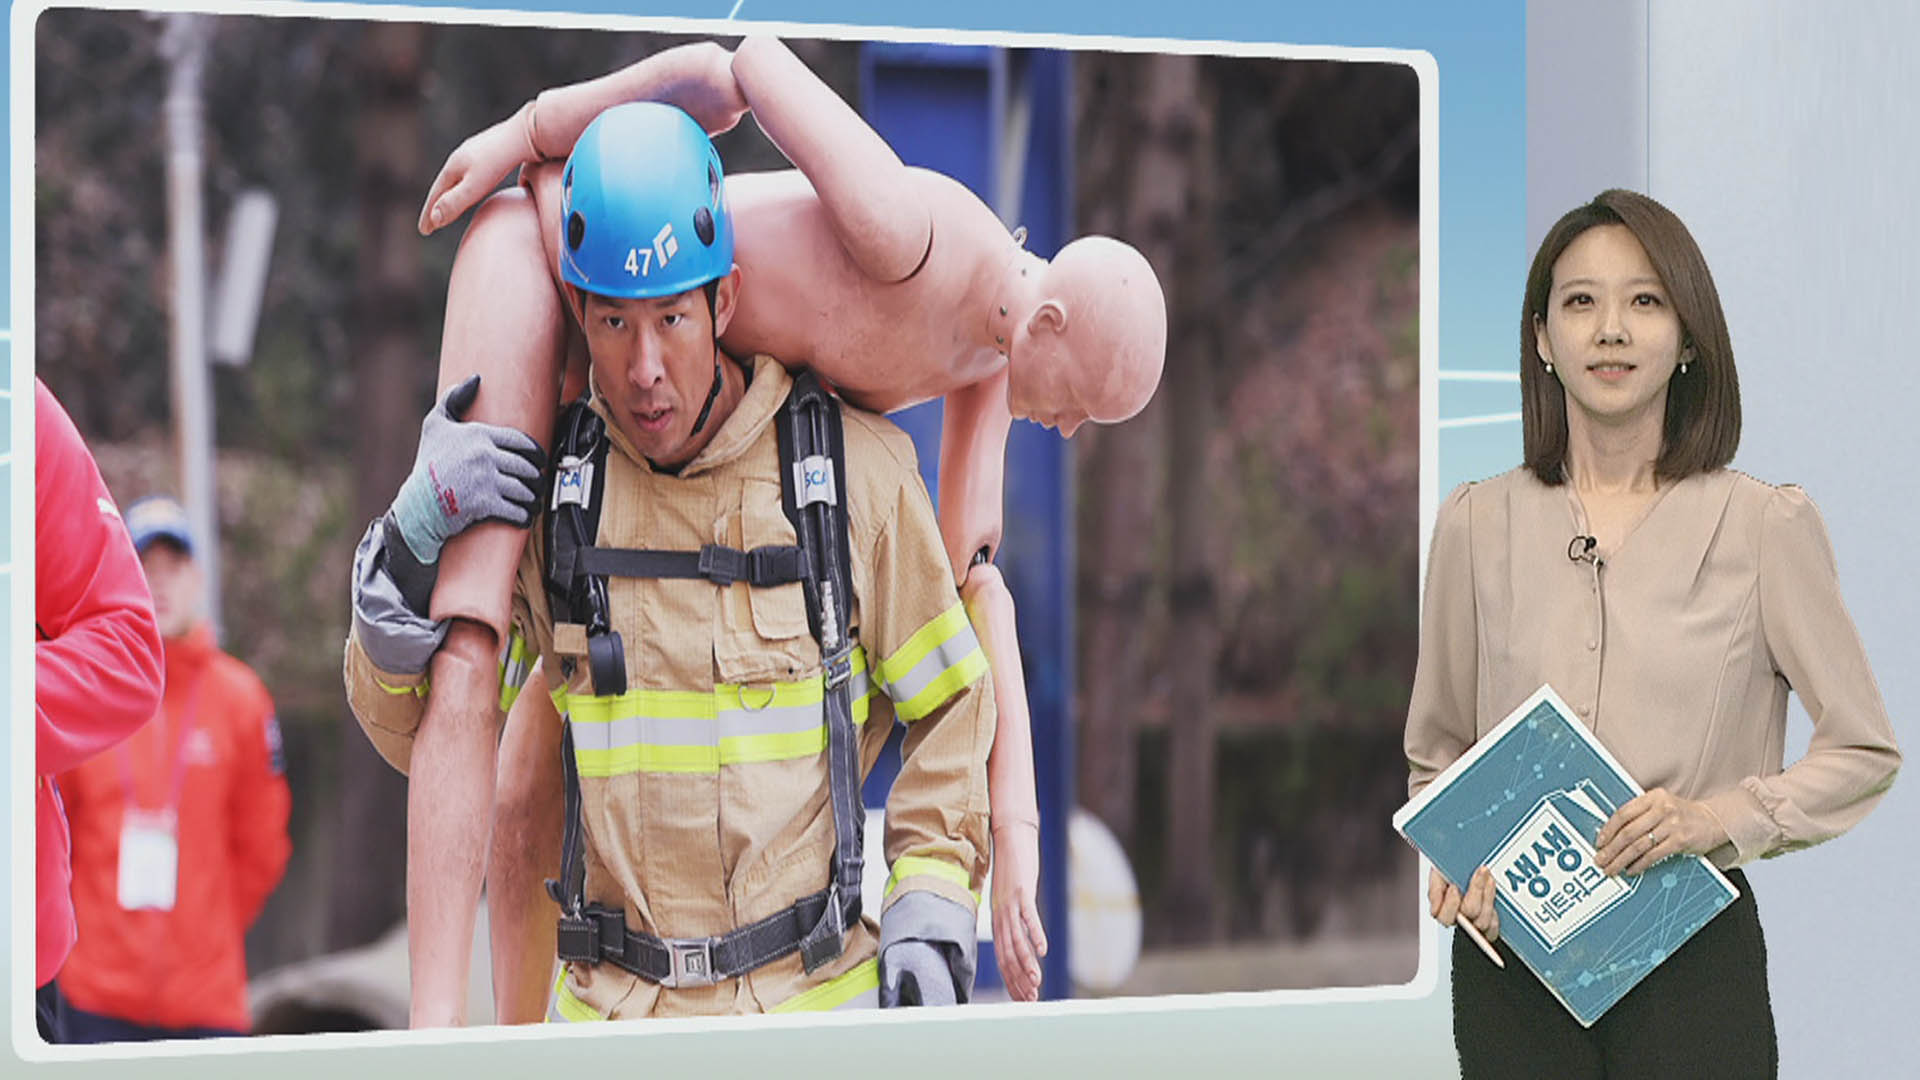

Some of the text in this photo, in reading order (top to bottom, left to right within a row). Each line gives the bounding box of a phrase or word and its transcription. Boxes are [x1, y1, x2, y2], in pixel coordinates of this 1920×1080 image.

[624, 248, 653, 277] 47
[1504, 823, 1582, 898] 생생
[1534, 866, 1609, 924] 네트워크
